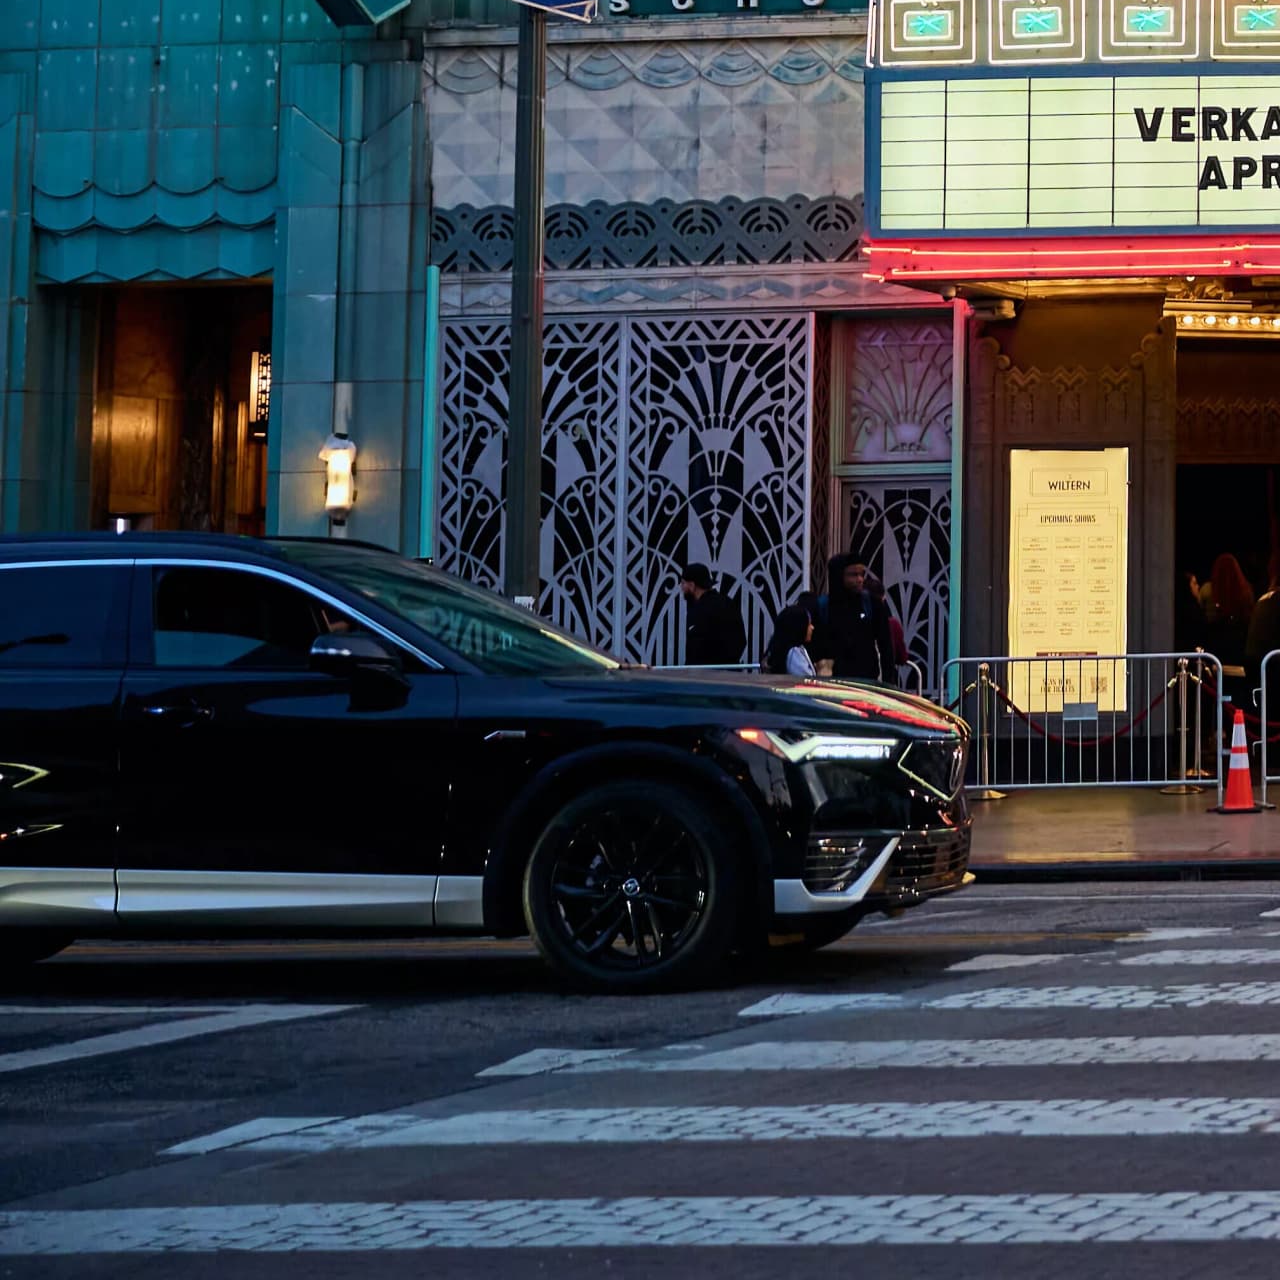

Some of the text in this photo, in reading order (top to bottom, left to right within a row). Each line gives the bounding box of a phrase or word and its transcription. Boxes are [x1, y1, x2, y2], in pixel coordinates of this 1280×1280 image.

[1048, 479, 1091, 491] WILTERN
[1040, 514, 1096, 524] UPCOMING SHOWS
